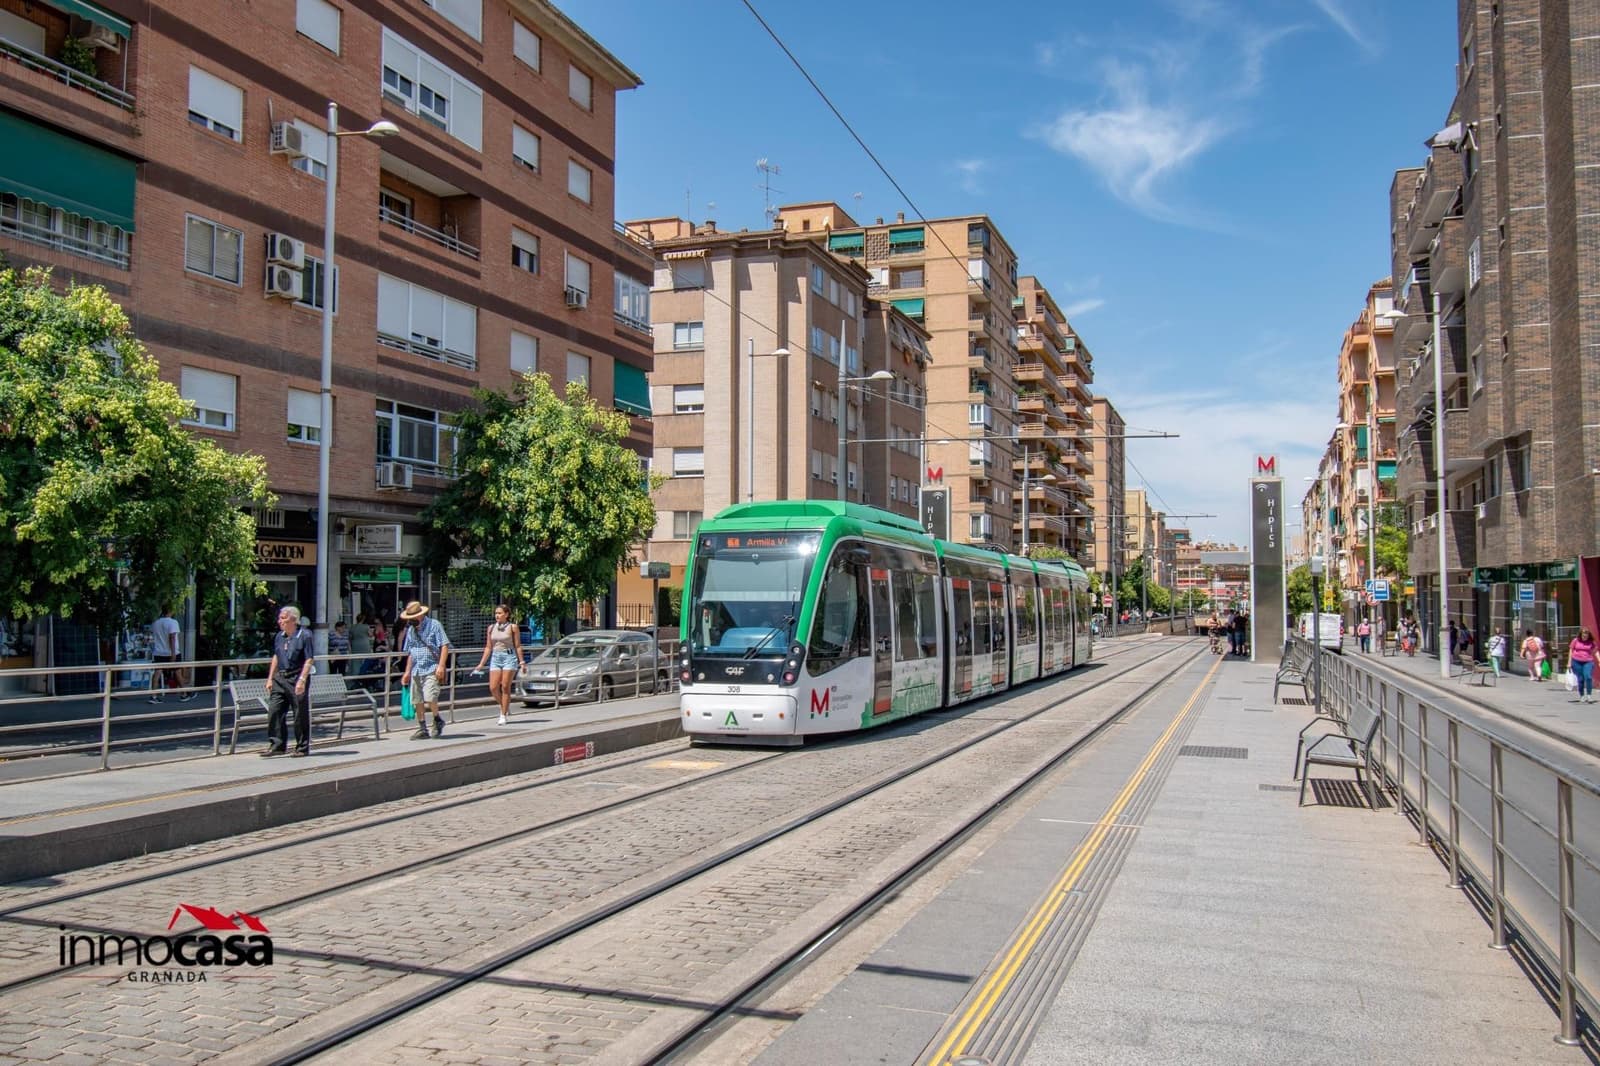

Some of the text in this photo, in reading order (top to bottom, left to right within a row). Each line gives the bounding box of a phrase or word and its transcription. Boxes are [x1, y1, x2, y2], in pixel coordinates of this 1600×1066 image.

[1257, 455, 1276, 474] M
[927, 466, 944, 484] M
[260, 543, 305, 559] GARDEN
[810, 687, 830, 719] M
